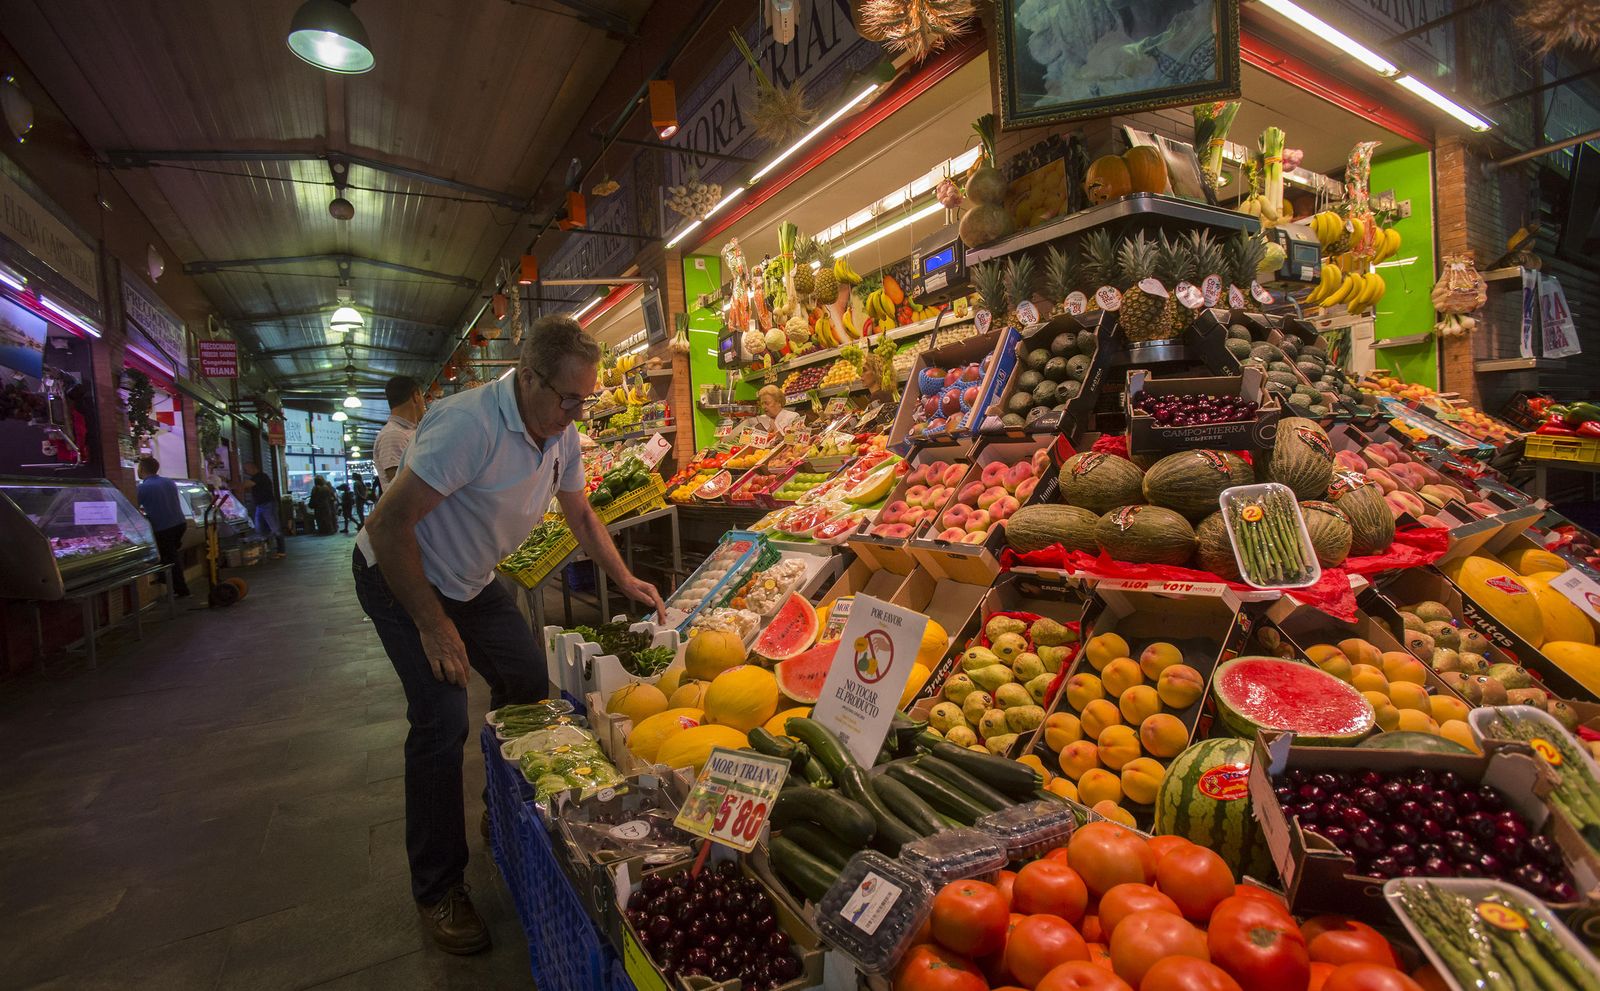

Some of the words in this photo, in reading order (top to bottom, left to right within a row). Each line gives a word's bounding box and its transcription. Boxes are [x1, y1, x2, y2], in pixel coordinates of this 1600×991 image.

[677, 82, 746, 186] MORA
[205, 367, 236, 376] TRIANA
[870, 607, 884, 620] POR
[884, 611, 903, 627] FAVOR
[1463, 603, 1515, 648] Frutas
[844, 679, 856, 692] NO
[856, 683, 879, 704] TOCAR
[924, 657, 953, 698] Frutas
[835, 687, 844, 700] EL
[843, 691, 880, 718] PRODUCTO
[711, 757, 738, 777] MORA
[739, 763, 779, 784] TRIANA
